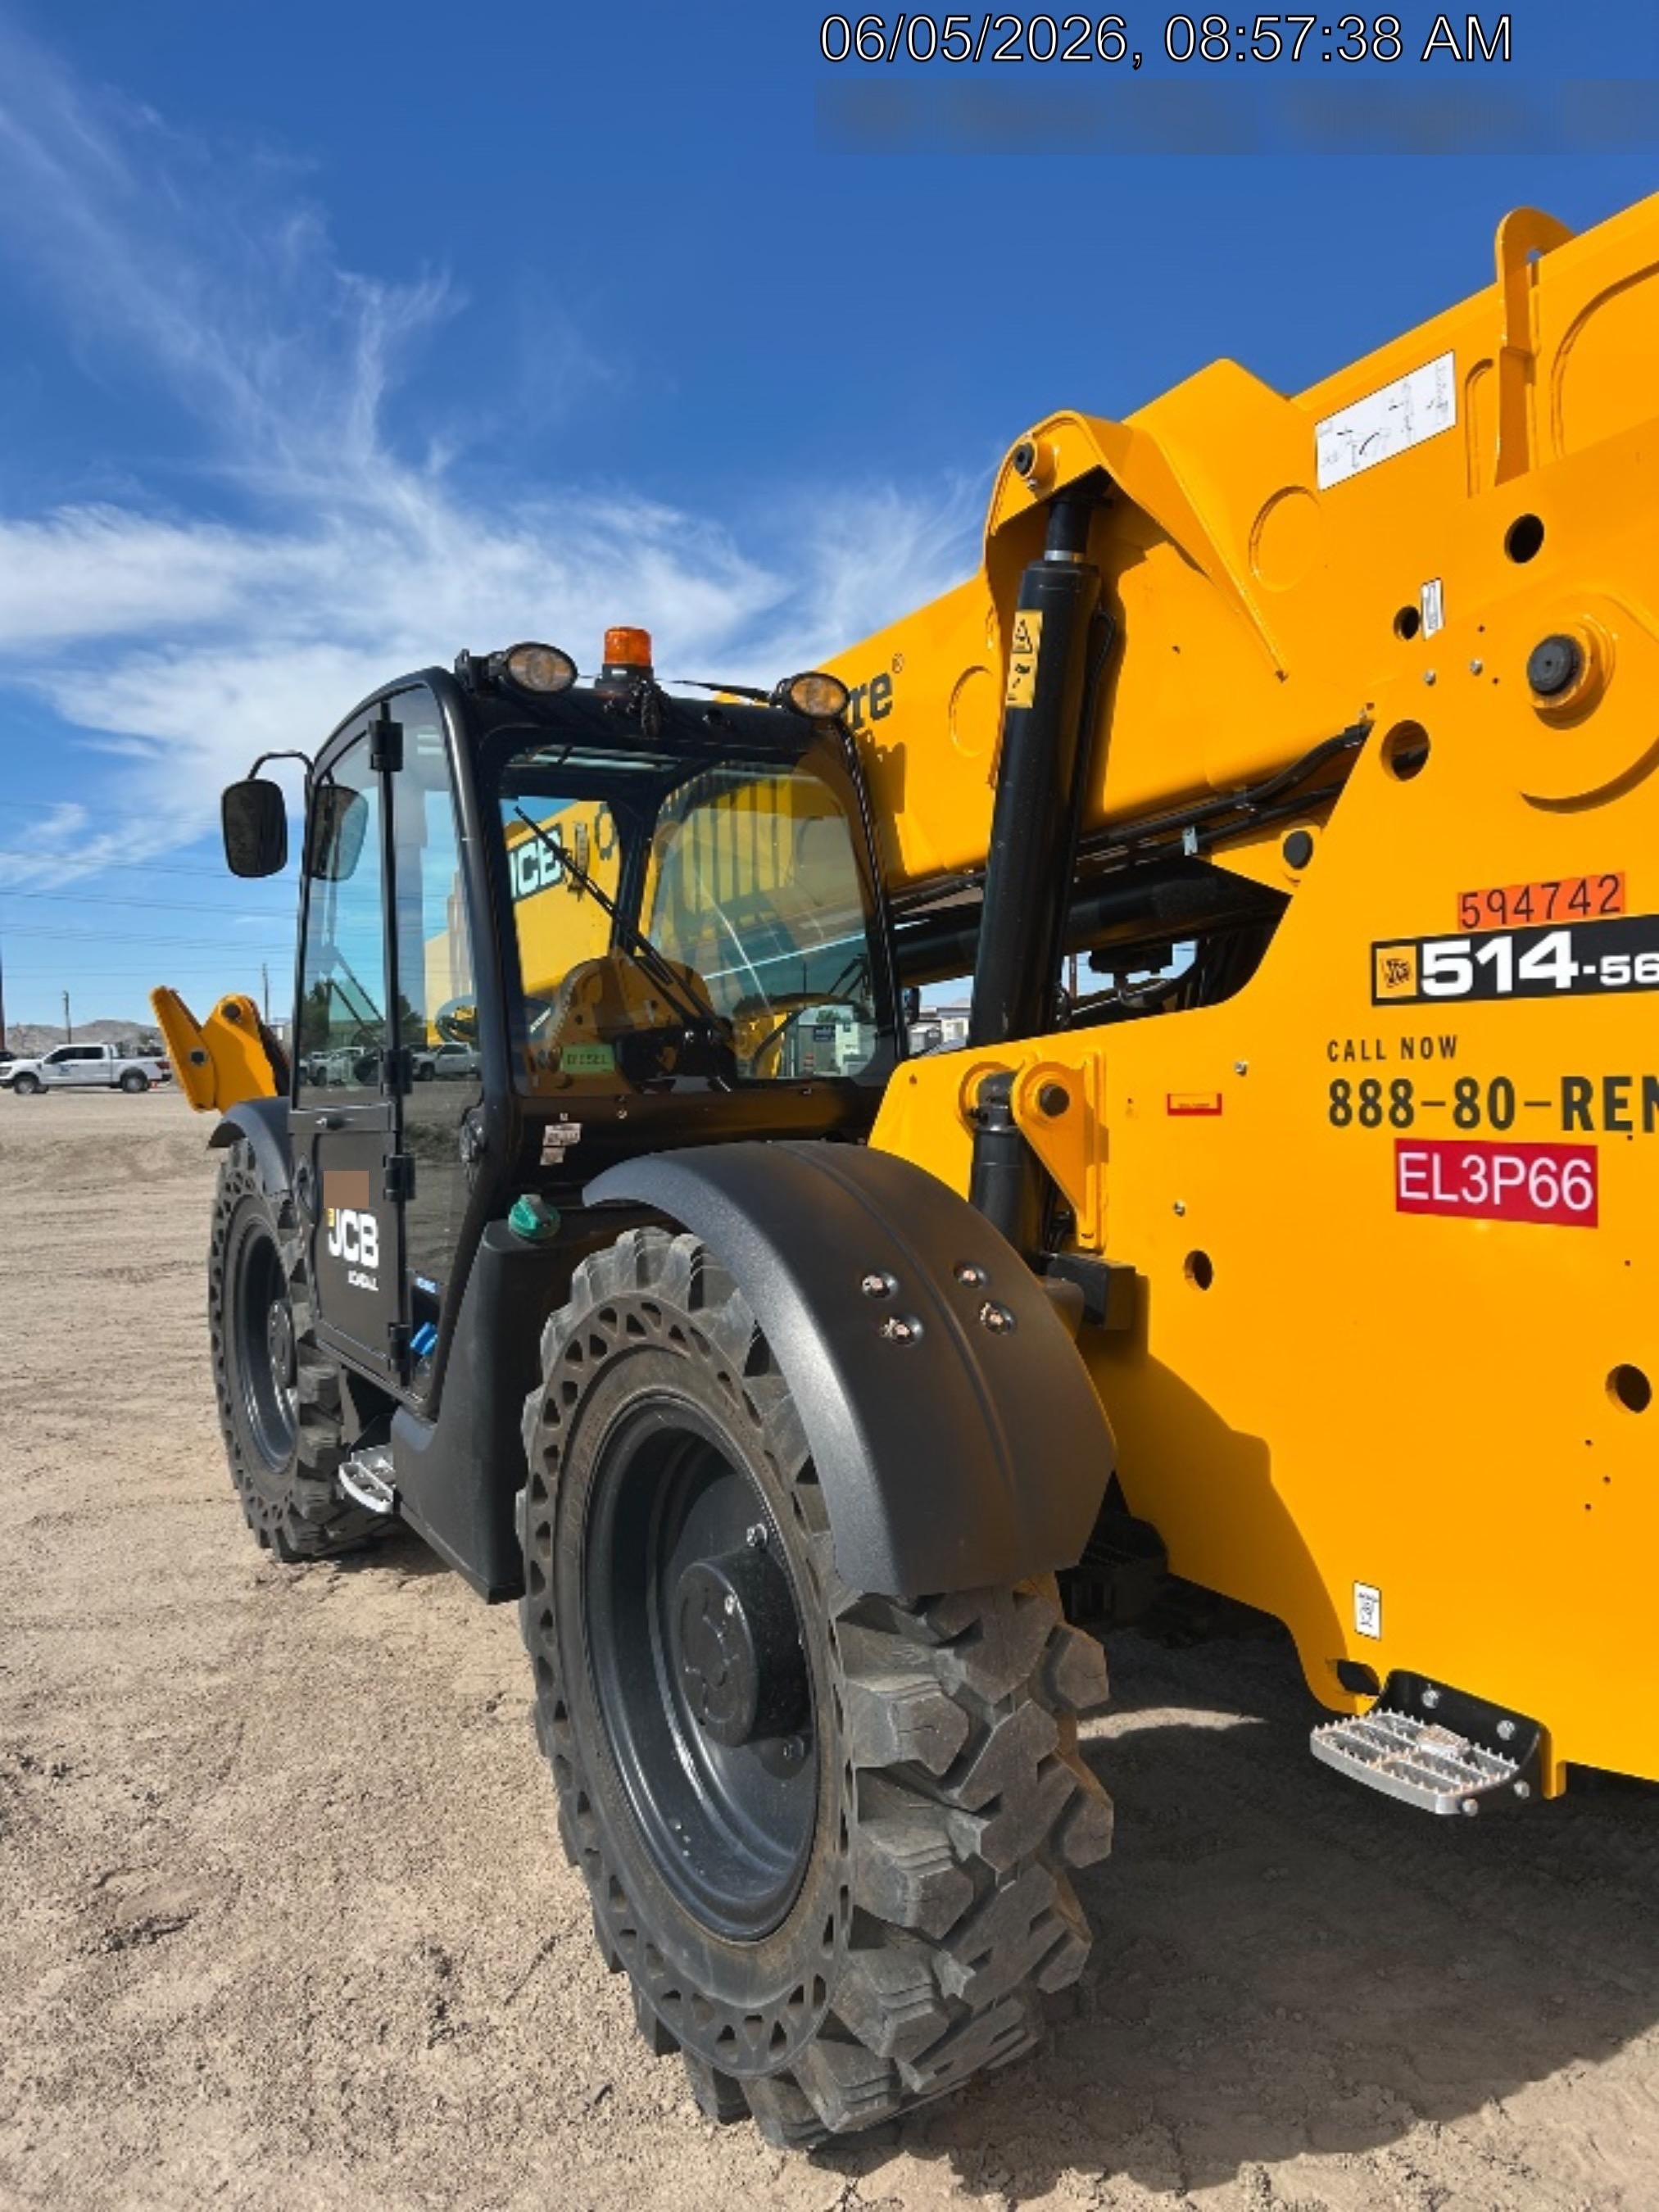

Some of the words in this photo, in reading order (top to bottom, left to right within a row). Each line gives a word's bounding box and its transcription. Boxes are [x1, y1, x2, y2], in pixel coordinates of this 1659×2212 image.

[1462, 874, 1621, 929] 594742
[1421, 931, 1659, 996] 514-56
[1327, 1039, 1386, 1062] CALL
[1401, 1035, 1457, 1060] NOW
[1398, 1151, 1593, 1211] EL3P66
[329, 1208, 378, 1268] JCB
